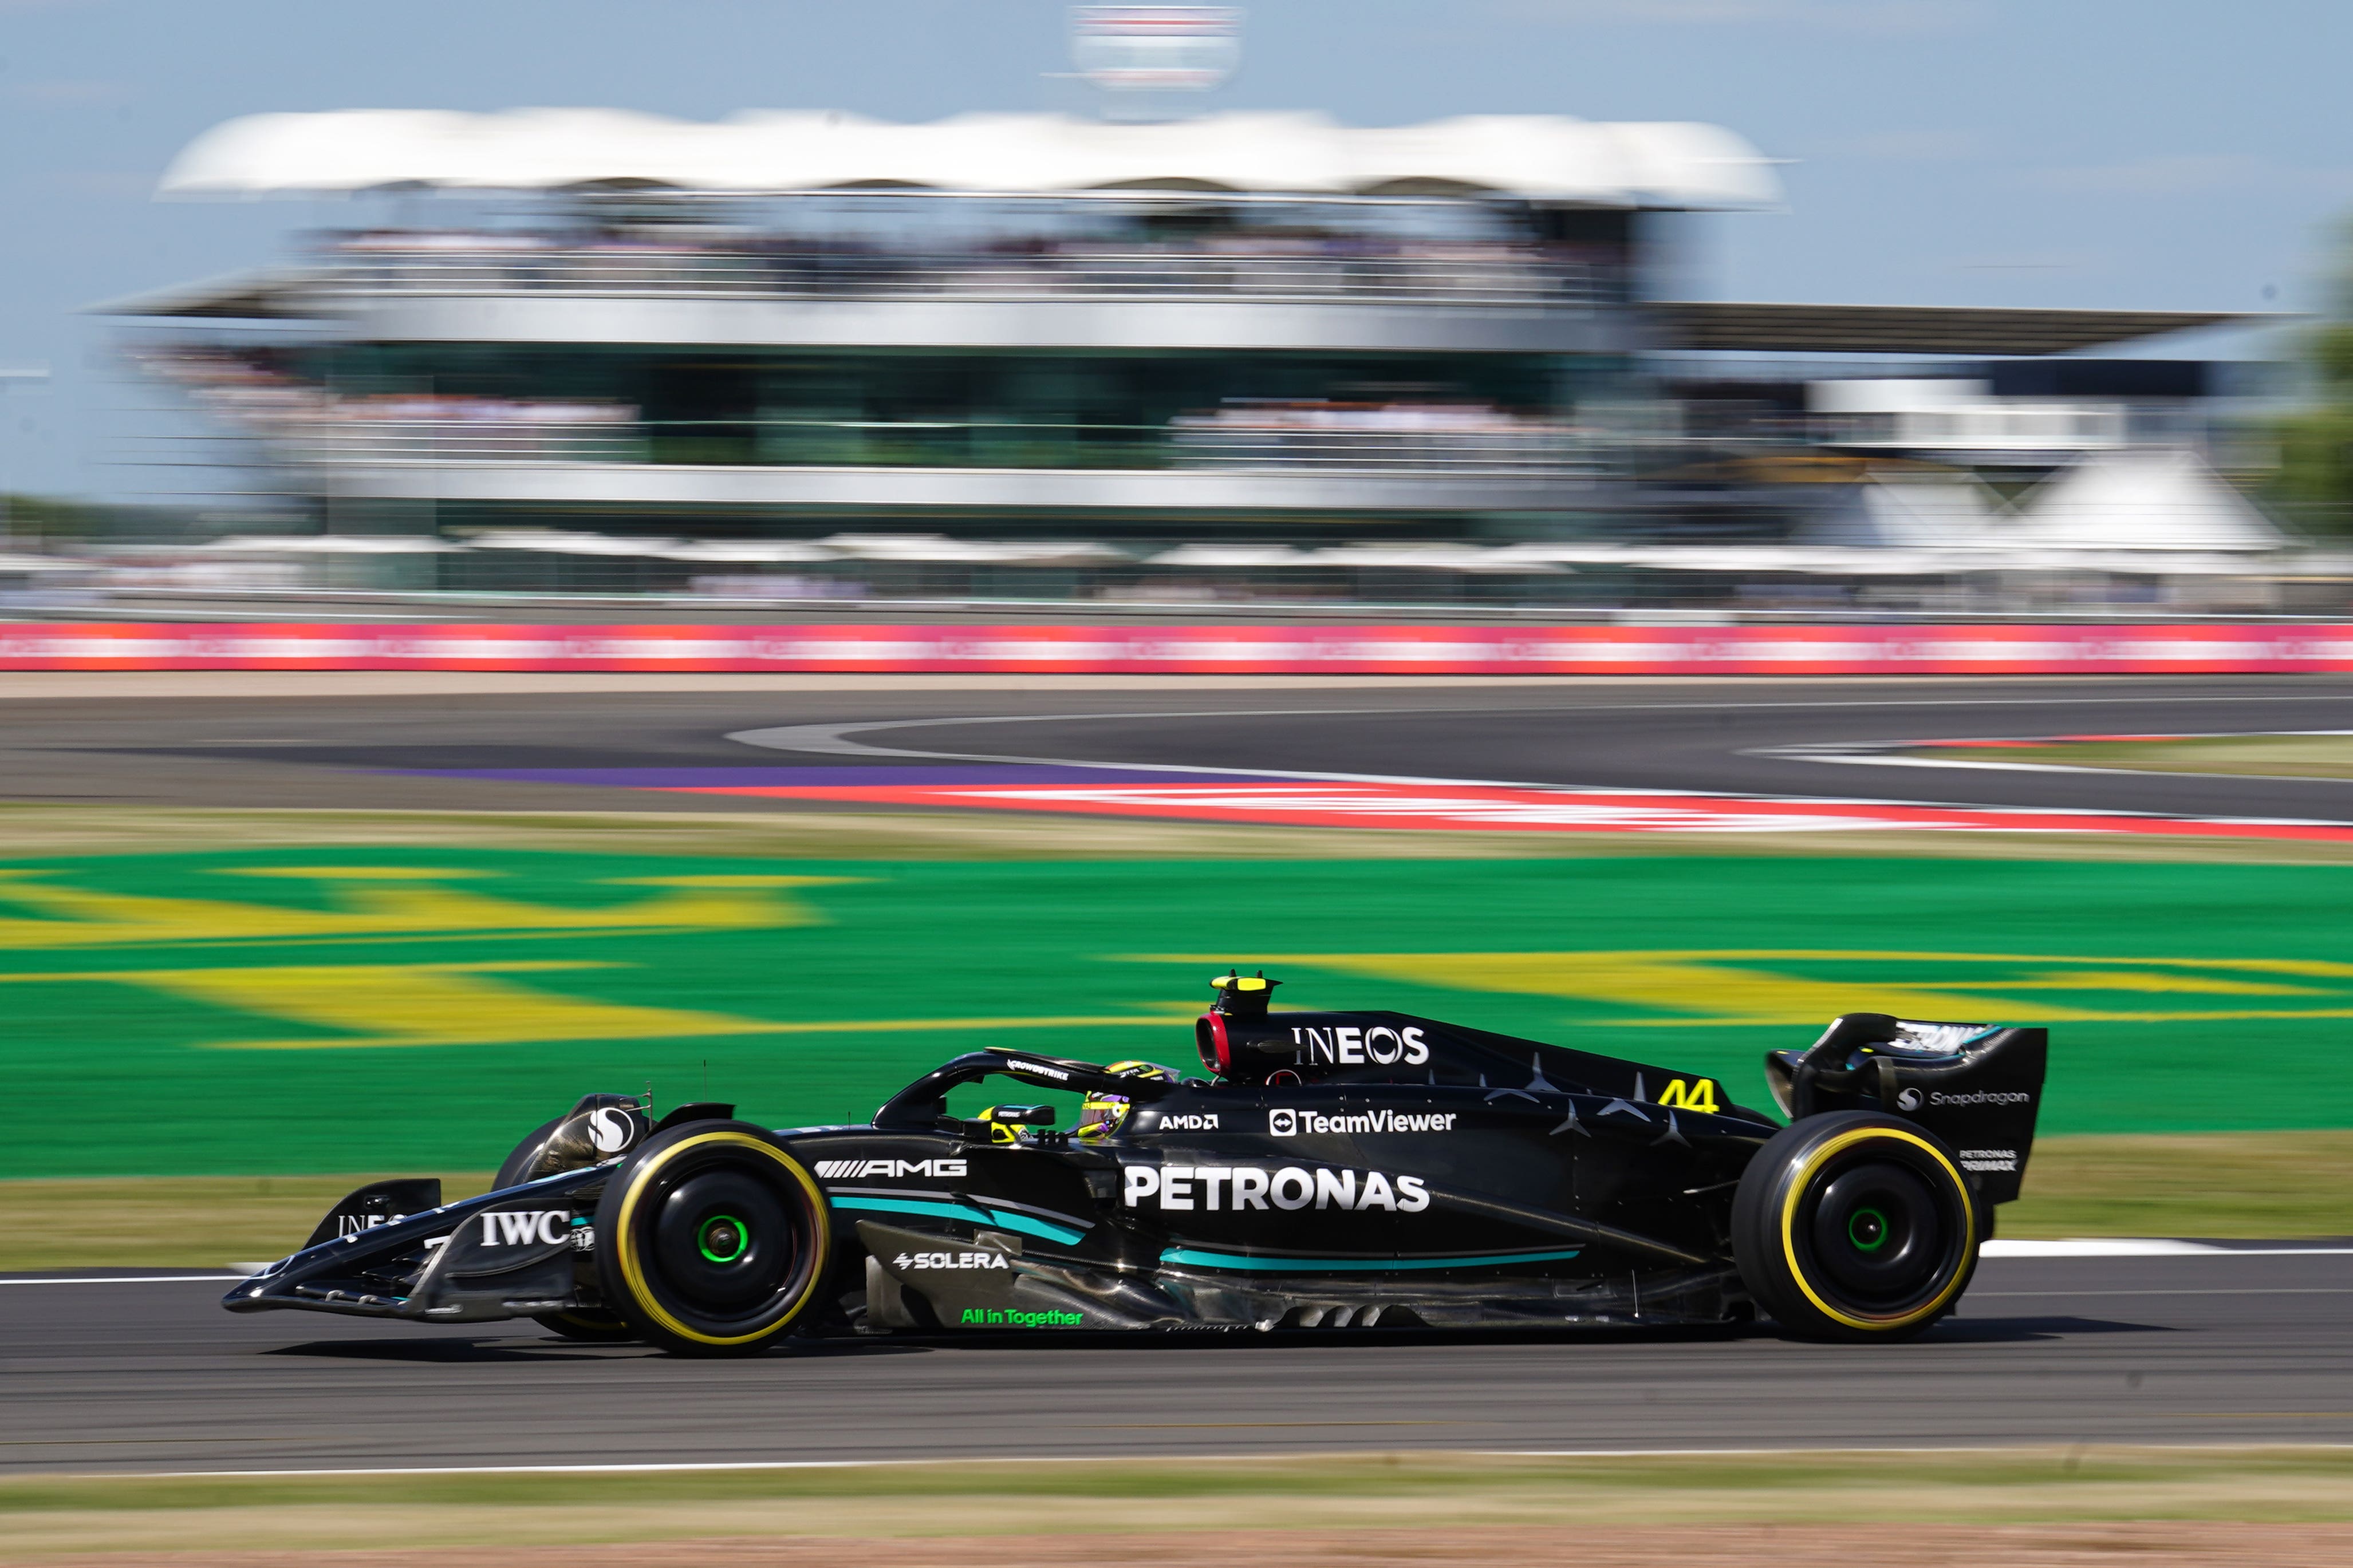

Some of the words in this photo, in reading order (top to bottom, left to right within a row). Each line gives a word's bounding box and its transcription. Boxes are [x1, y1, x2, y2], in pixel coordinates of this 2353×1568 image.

[1291, 1026, 1430, 1065] INEOS
[1010, 1059, 1069, 1081] CROWDSTRIKE
[1657, 1079, 1720, 1115] 44
[1929, 1089, 2030, 1107] Snapdragon
[1158, 1115, 1203, 1130] AMD
[1298, 1109, 1457, 1133] TeamViewer
[1960, 1150, 2017, 1159] PETRONAS
[857, 1159, 967, 1178] AMG
[1124, 1166, 1430, 1212] PETRONAS
[480, 1210, 571, 1246] IWC
[913, 1252, 1010, 1269] SOLERA
[960, 1309, 984, 1324] All
[987, 1309, 1003, 1324] in
[1004, 1309, 1084, 1328] Together
